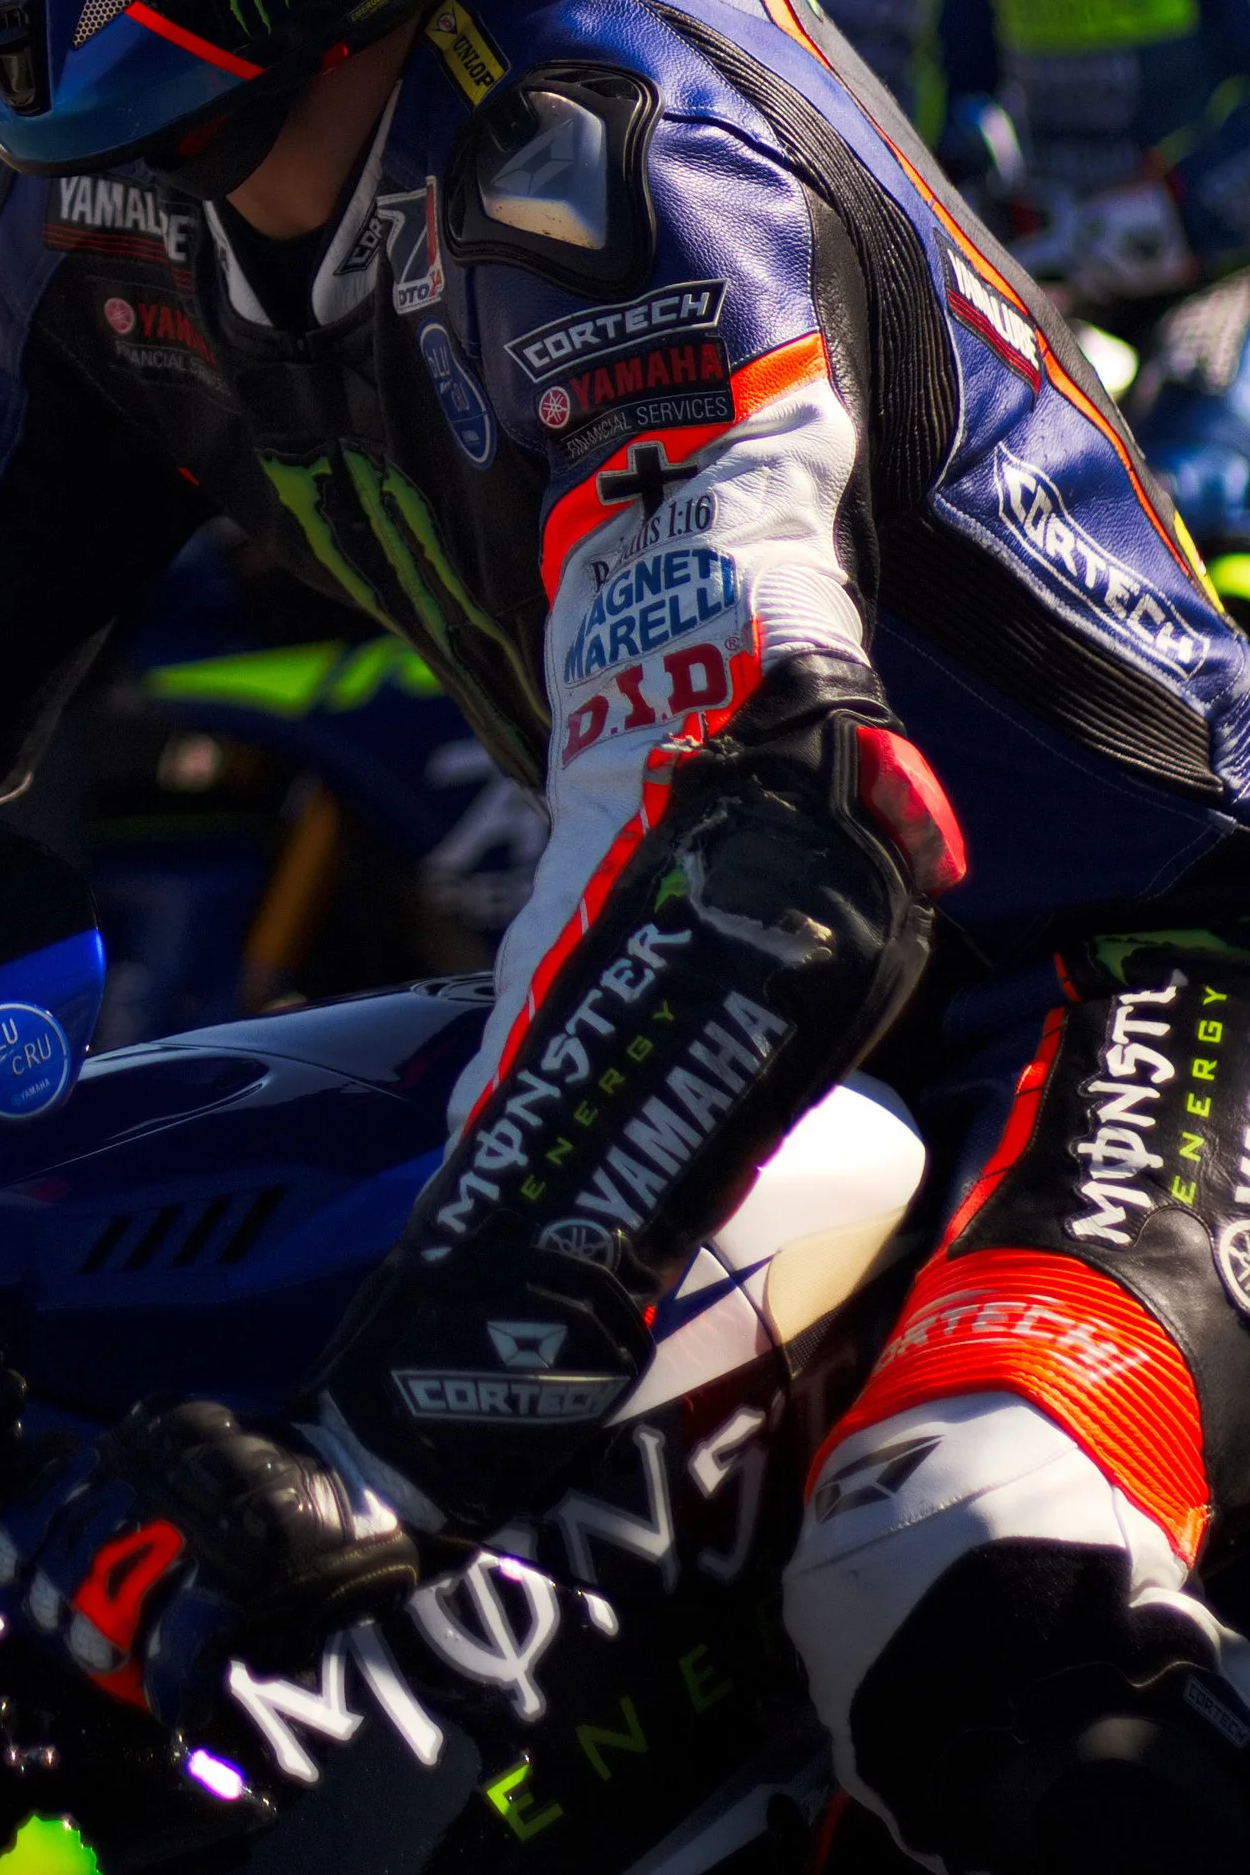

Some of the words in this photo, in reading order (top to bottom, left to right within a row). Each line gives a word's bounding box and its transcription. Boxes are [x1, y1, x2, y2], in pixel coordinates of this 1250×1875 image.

[522, 291, 711, 369] CORTECH
[569, 341, 726, 411] YAMAHA
[567, 412, 633, 460] FINANCIAL
[636, 396, 729, 425] SERVICES
[667, 495, 711, 538] 1:16
[1003, 466, 1195, 664] CORTECH
[436, 922, 693, 1234] MONSTER
[518, 997, 675, 1202] ENERGY
[574, 990, 790, 1233] YAMAHA
[1171, 985, 1228, 1205] ENERGY
[407, 1378, 624, 1418] CORTECH
